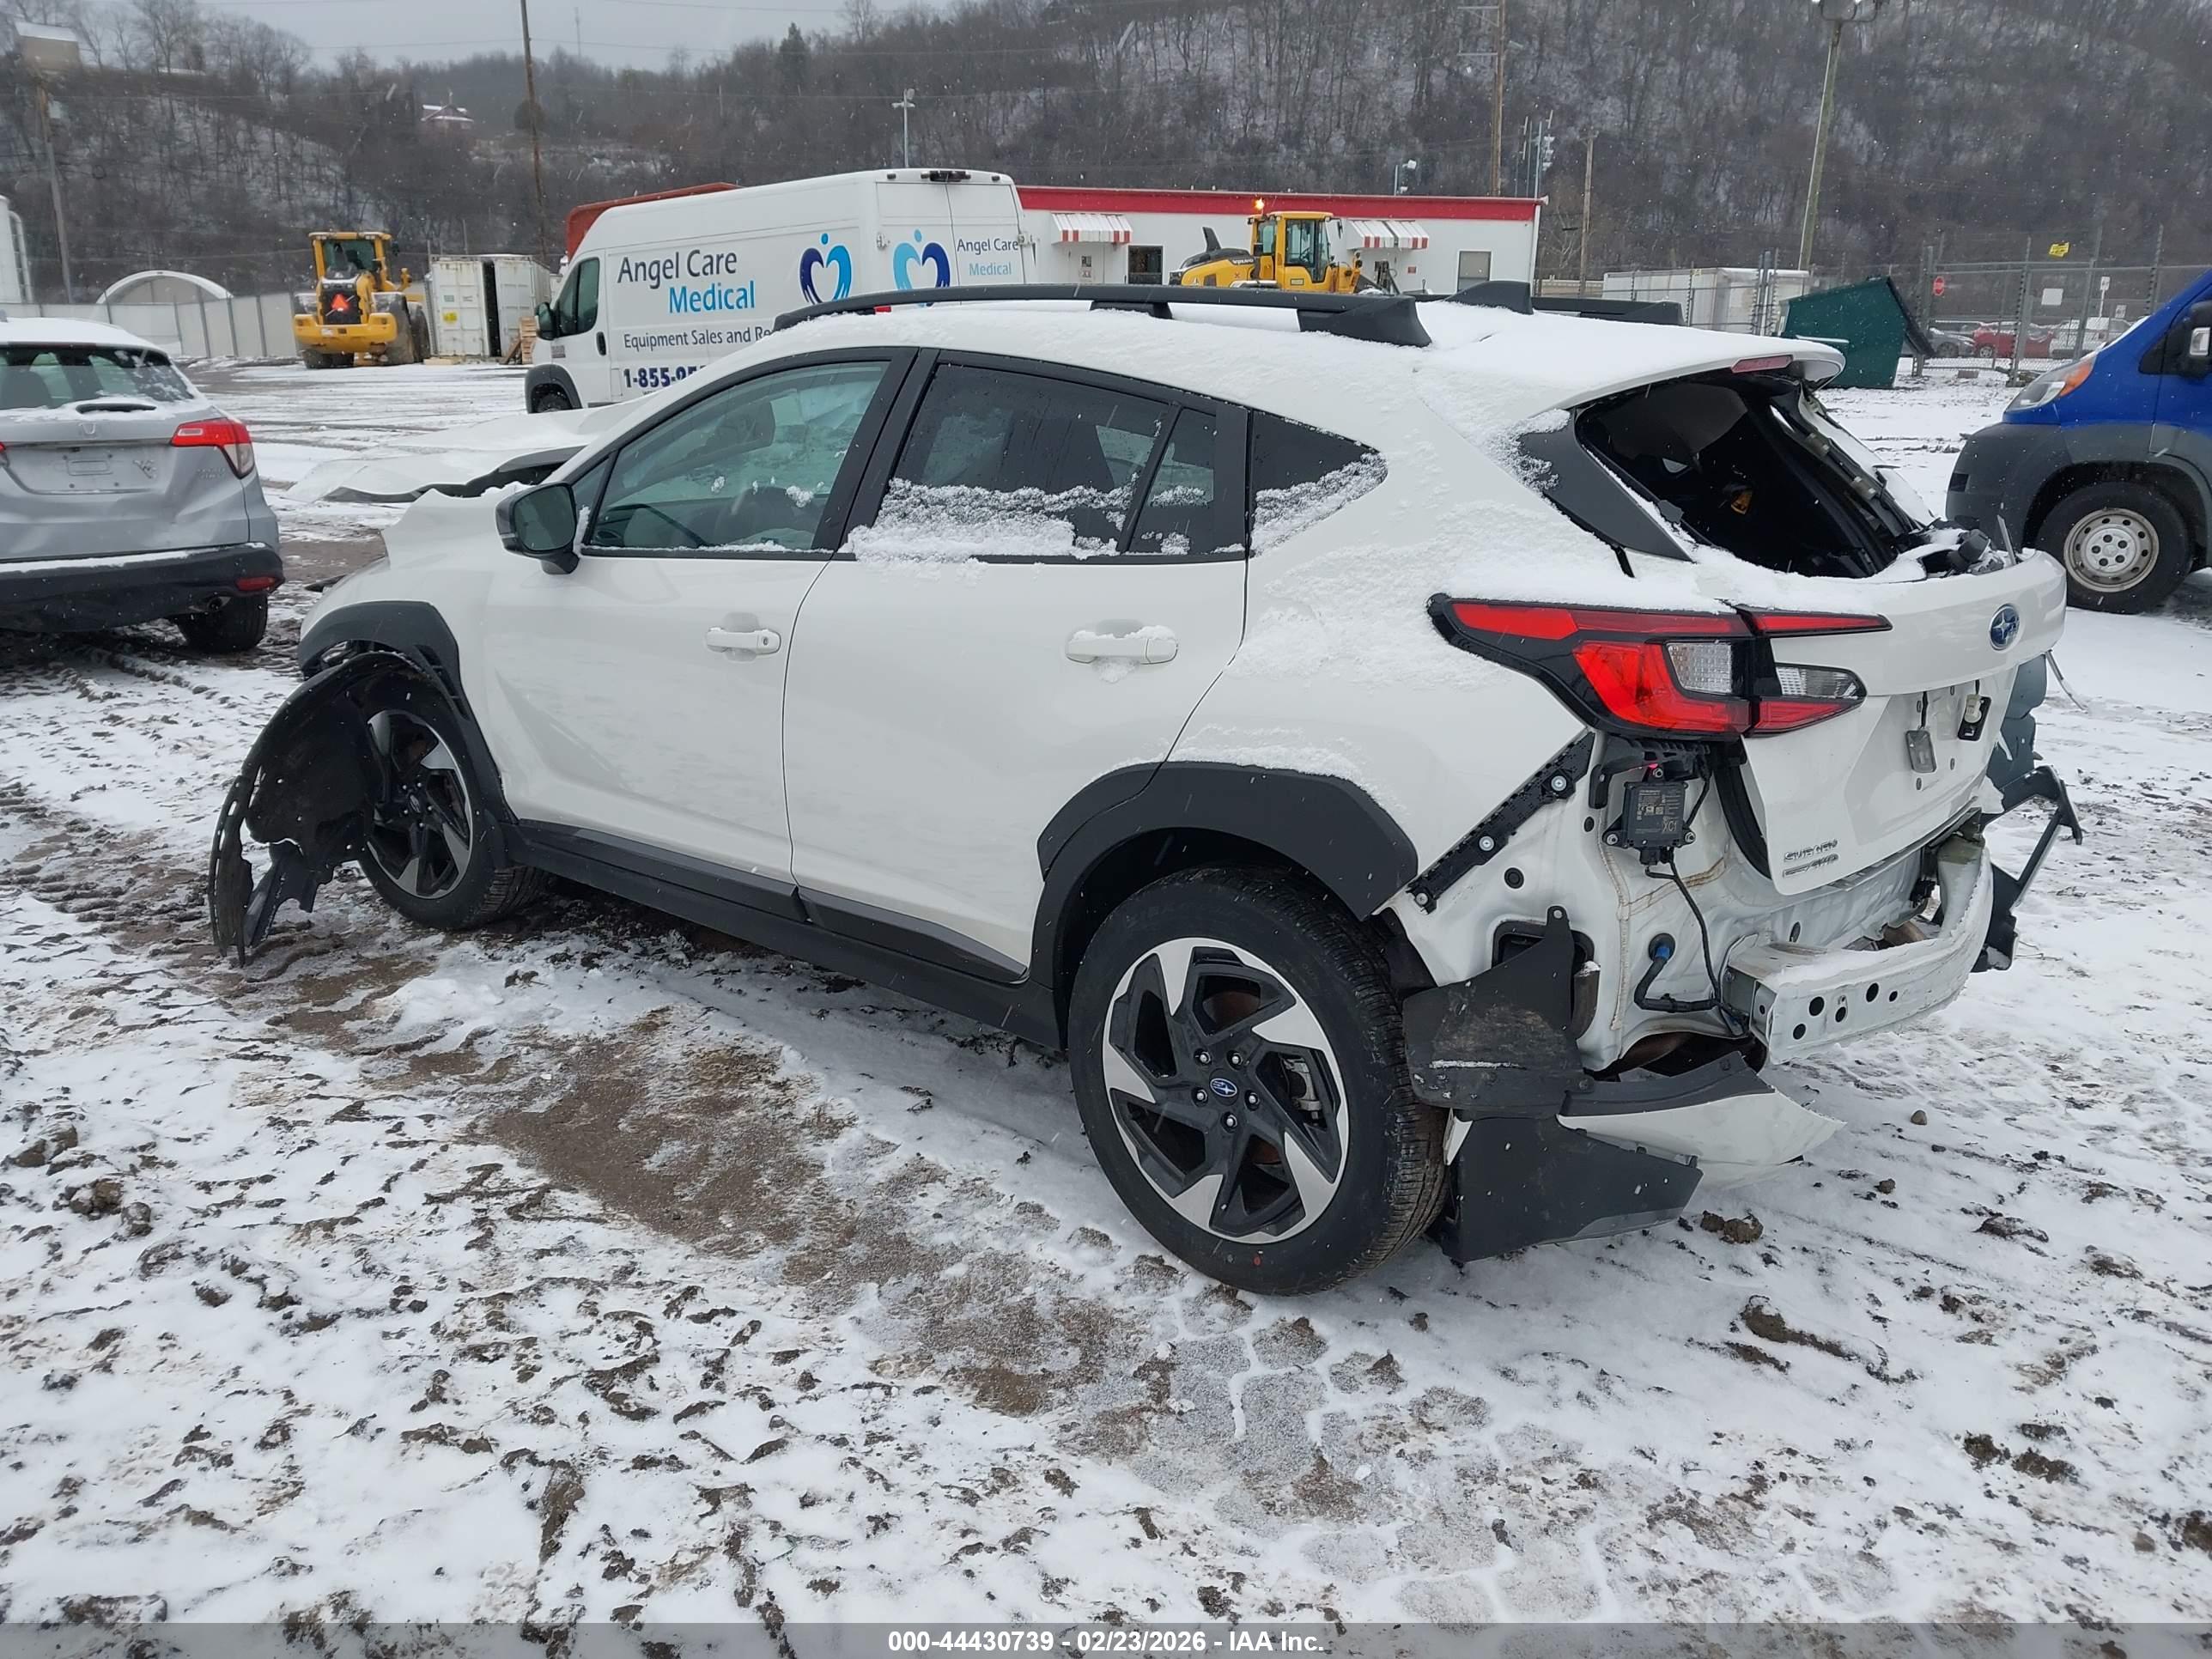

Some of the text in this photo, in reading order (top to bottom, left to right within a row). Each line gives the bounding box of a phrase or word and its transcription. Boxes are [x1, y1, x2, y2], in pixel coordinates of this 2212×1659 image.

[957, 238, 1018, 256] Angel Care
[617, 249, 738, 289] Angel Care
[969, 261, 1012, 276] Medical
[669, 279, 756, 313] Medical
[623, 331, 688, 352] Equipment
[691, 329, 723, 345] Sales
[726, 327, 751, 343] and
